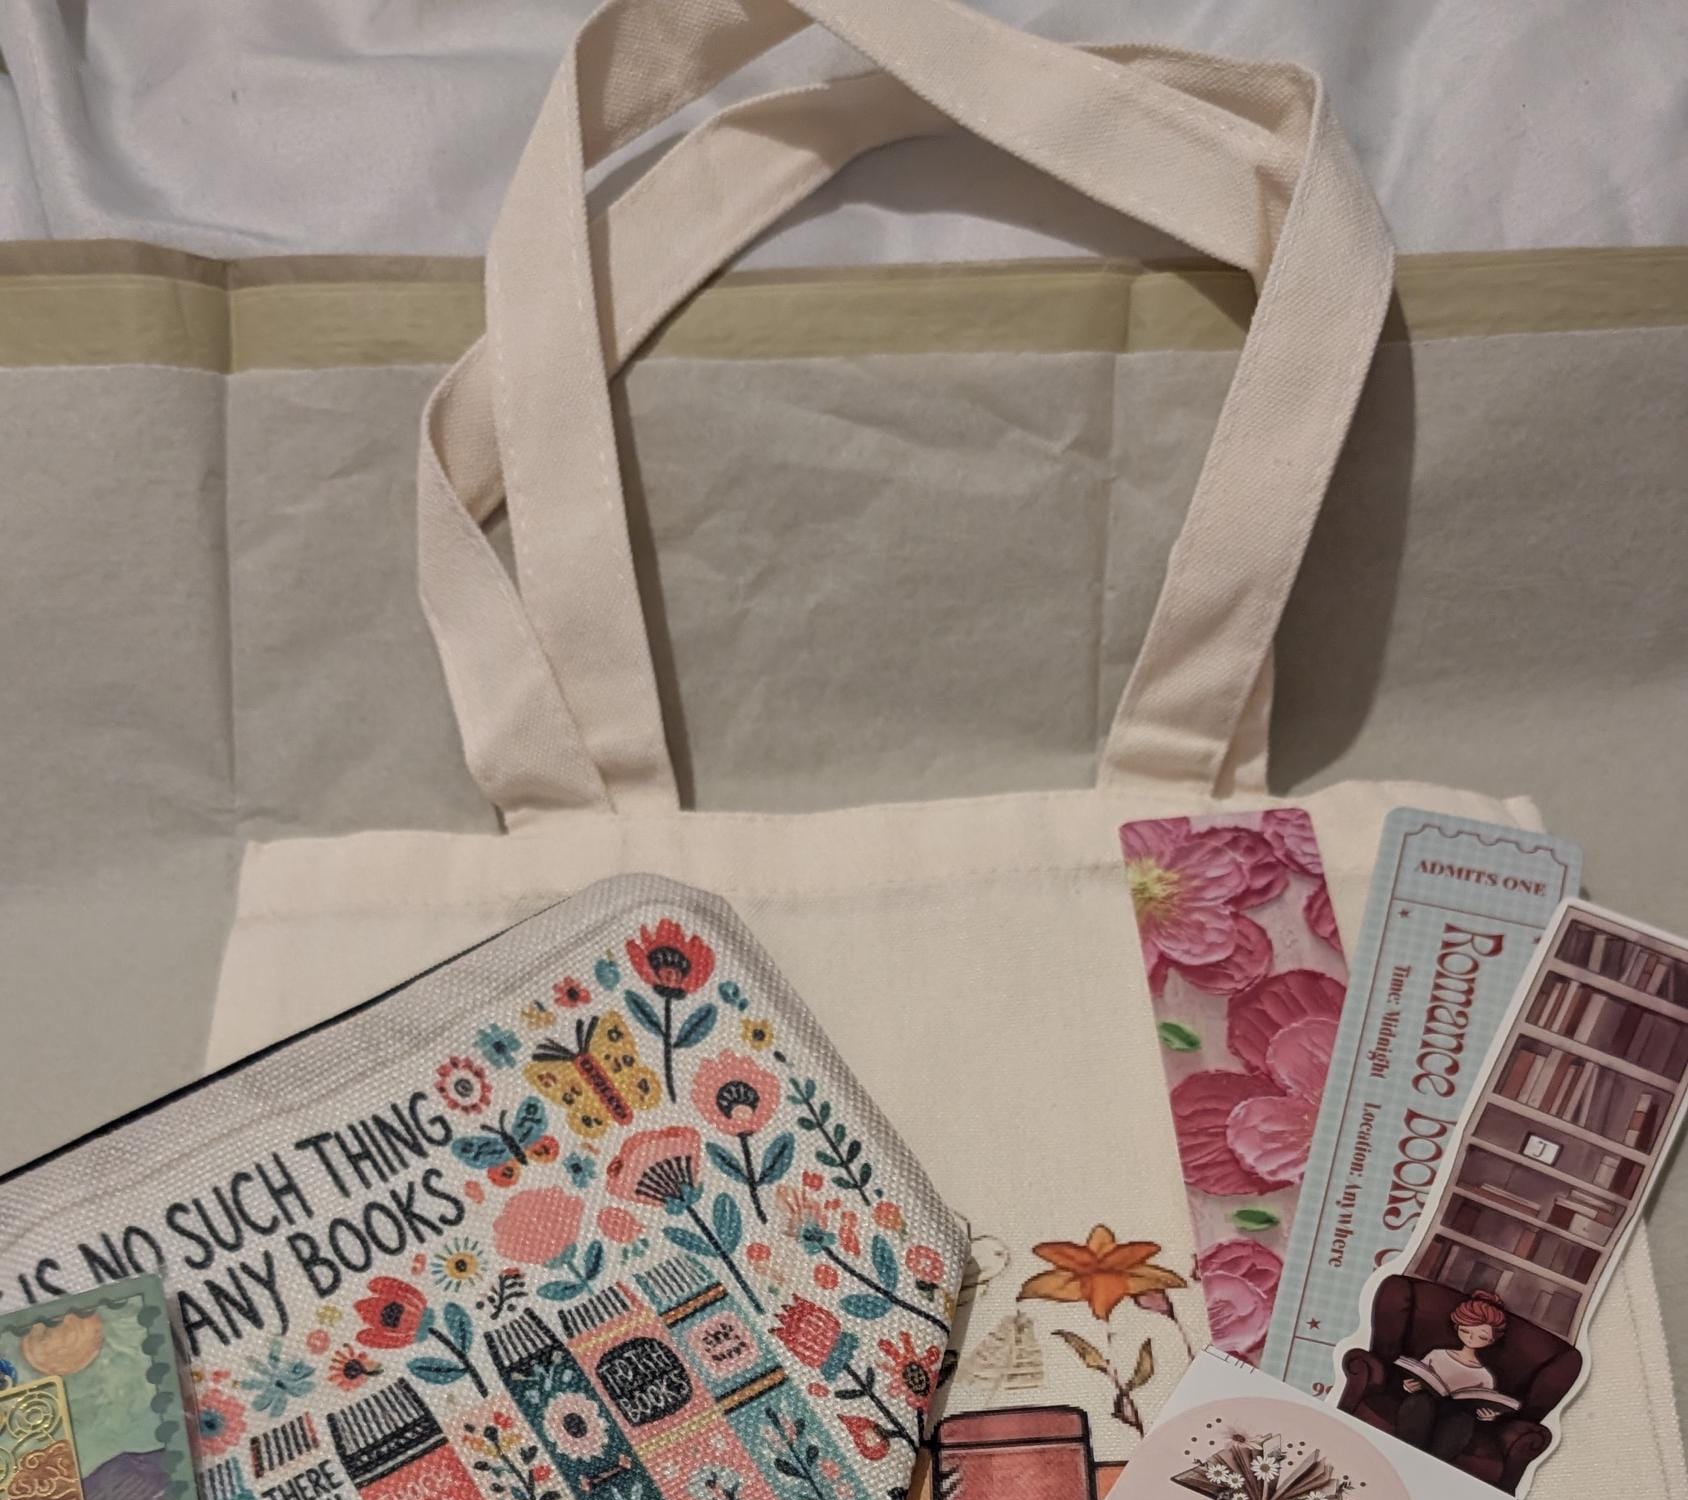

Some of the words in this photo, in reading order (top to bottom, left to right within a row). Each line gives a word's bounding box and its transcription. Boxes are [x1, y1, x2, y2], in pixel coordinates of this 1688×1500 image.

[1414, 859, 1498, 887] ADMITS
[1502, 878, 1547, 897] ONE
[1387, 965, 1412, 1005] Time:
[1411, 923, 1505, 1099] Romance
[1367, 1008, 1401, 1079] Midnight
[1350, 1102, 1382, 1178] Location:
[77, 1225, 166, 1285] NO
[166, 1151, 315, 1270] SUCH
[294, 1091, 453, 1198] THING
[1328, 1184, 1362, 1268] Anywhere
[286, 1168, 465, 1298] BOOKS
[619, 1370, 689, 1423] BOOKS
